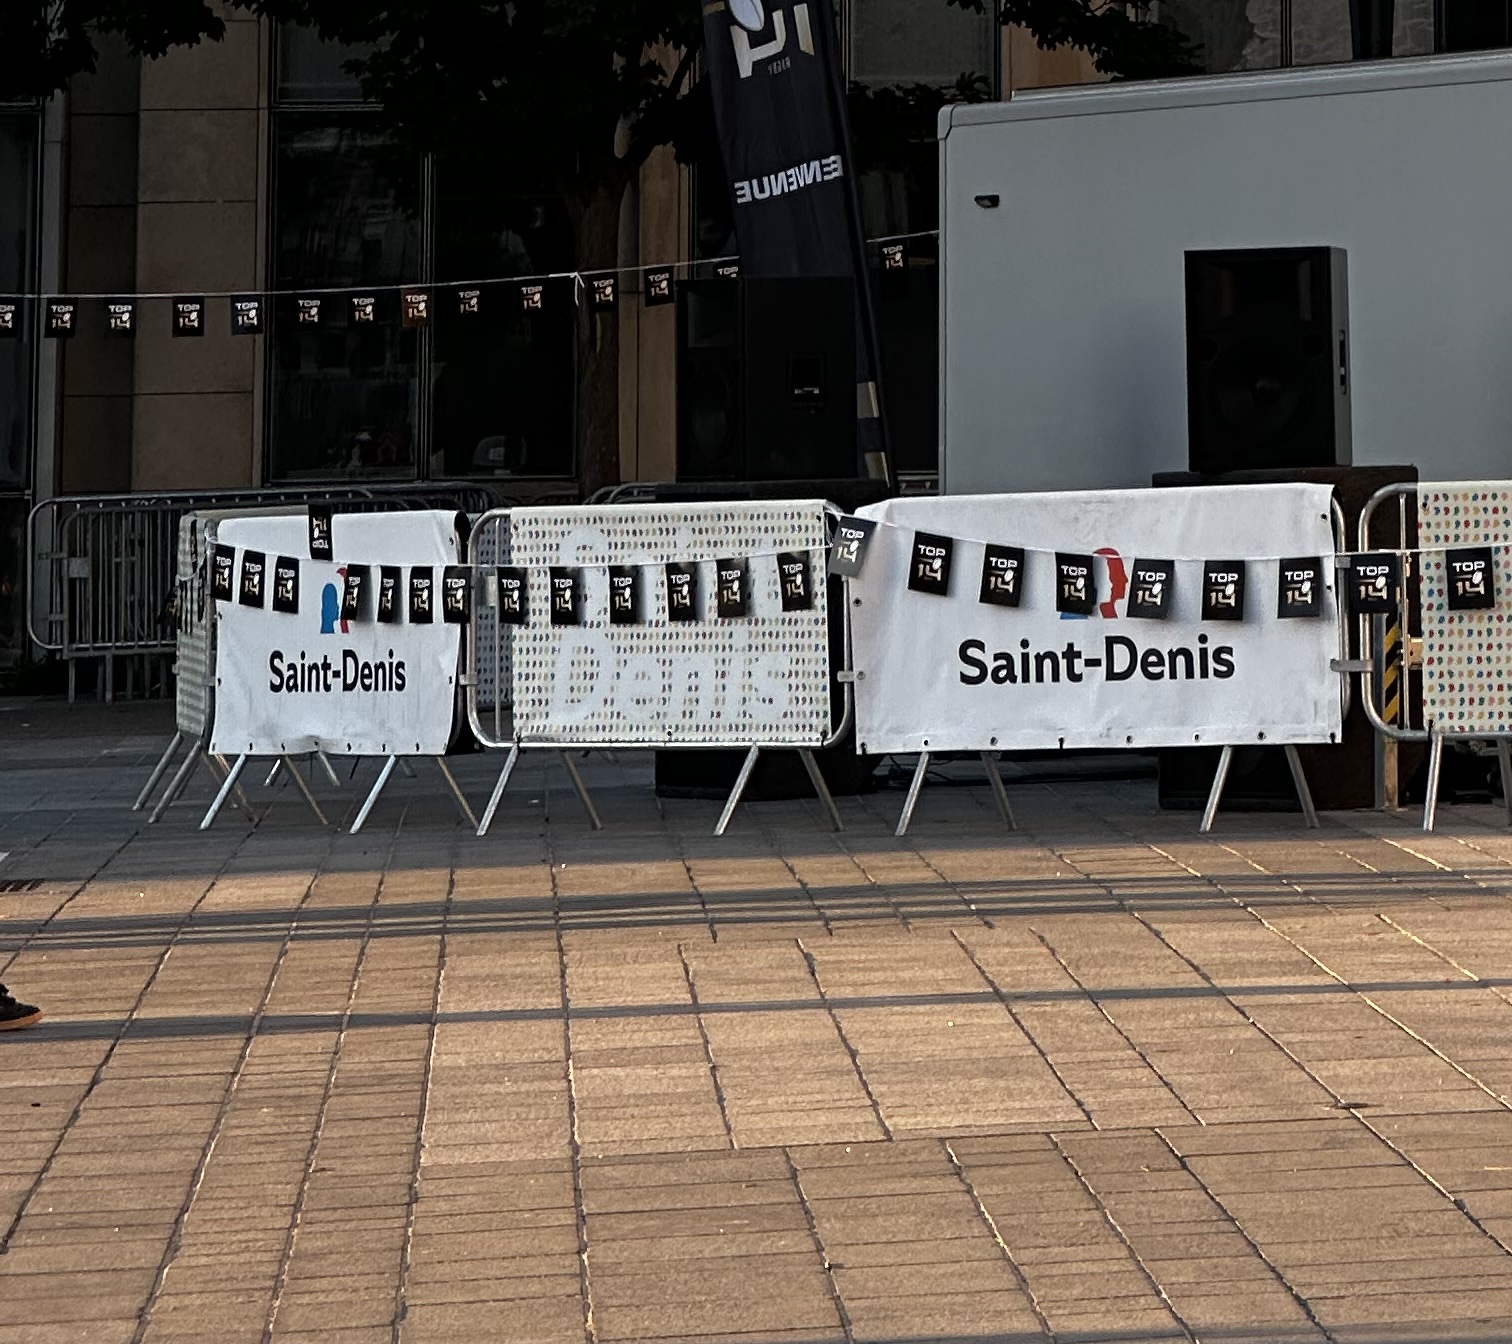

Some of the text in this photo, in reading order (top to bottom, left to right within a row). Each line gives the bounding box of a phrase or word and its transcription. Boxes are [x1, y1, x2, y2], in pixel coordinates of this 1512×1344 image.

[841, 528, 864, 539] TOP
[837, 546, 857, 562] 14
[918, 545, 945, 557] TOP
[990, 557, 1017, 568] TOP
[1453, 561, 1485, 572] TOP
[918, 564, 941, 581] 14
[1061, 565, 1087, 576] TOP
[1137, 571, 1166, 582] TOP
[1209, 572, 1238, 583] TOP
[1285, 571, 1314, 581] TOP
[1357, 566, 1389, 576] TOP
[990, 576, 1014, 593] 14
[1063, 584, 1085, 600] 14
[1359, 584, 1387, 600] 14
[1456, 581, 1484, 596] 14
[1136, 590, 1162, 606] 14
[1210, 591, 1235, 606] 14
[1286, 589, 1312, 604] 14
[958, 634, 1235, 686] Saint-Denis
[269, 649, 406, 693] Saint-Denis
